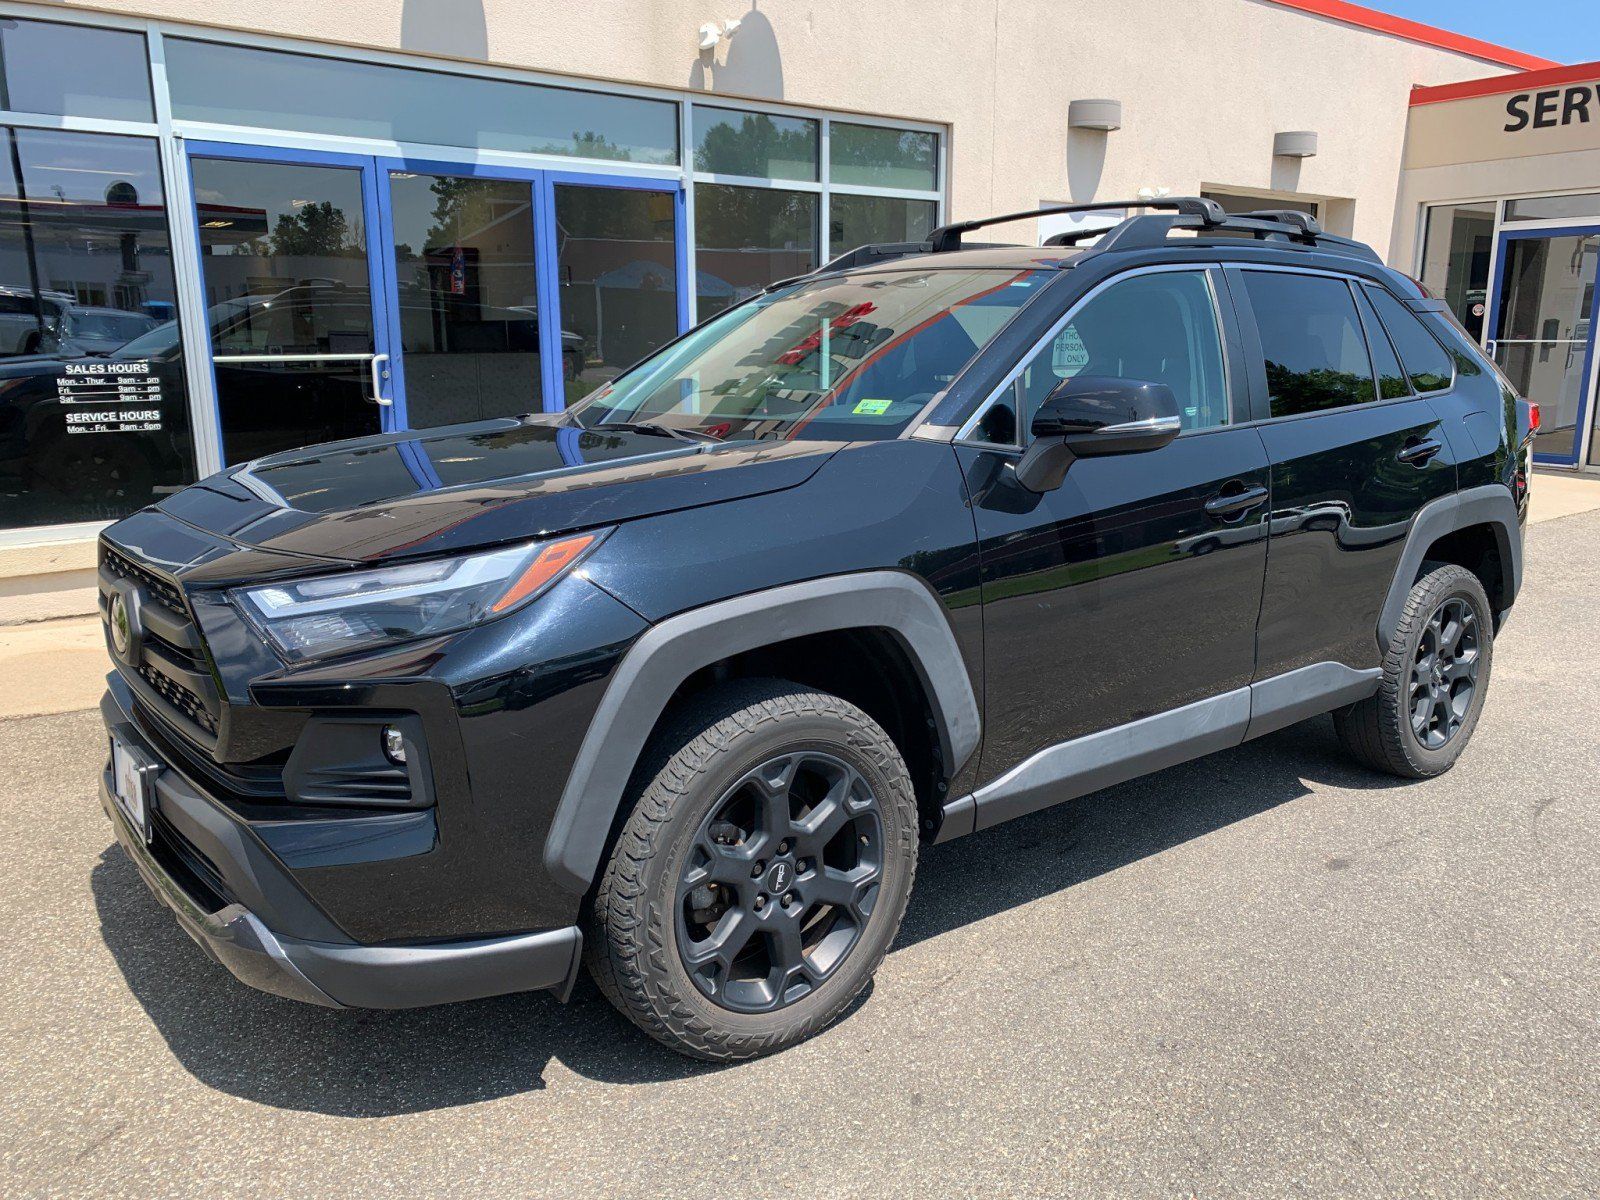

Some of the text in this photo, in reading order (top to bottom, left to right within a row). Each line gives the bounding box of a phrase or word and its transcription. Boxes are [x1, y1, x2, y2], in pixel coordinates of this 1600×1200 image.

[1067, 355, 1085, 363] ONLY
[65, 364, 149, 374] SALES HOURS
[86, 377, 106, 385] Thur.
[65, 411, 160, 422] SERVICE HOURS
[67, 426, 88, 434] Mon.
